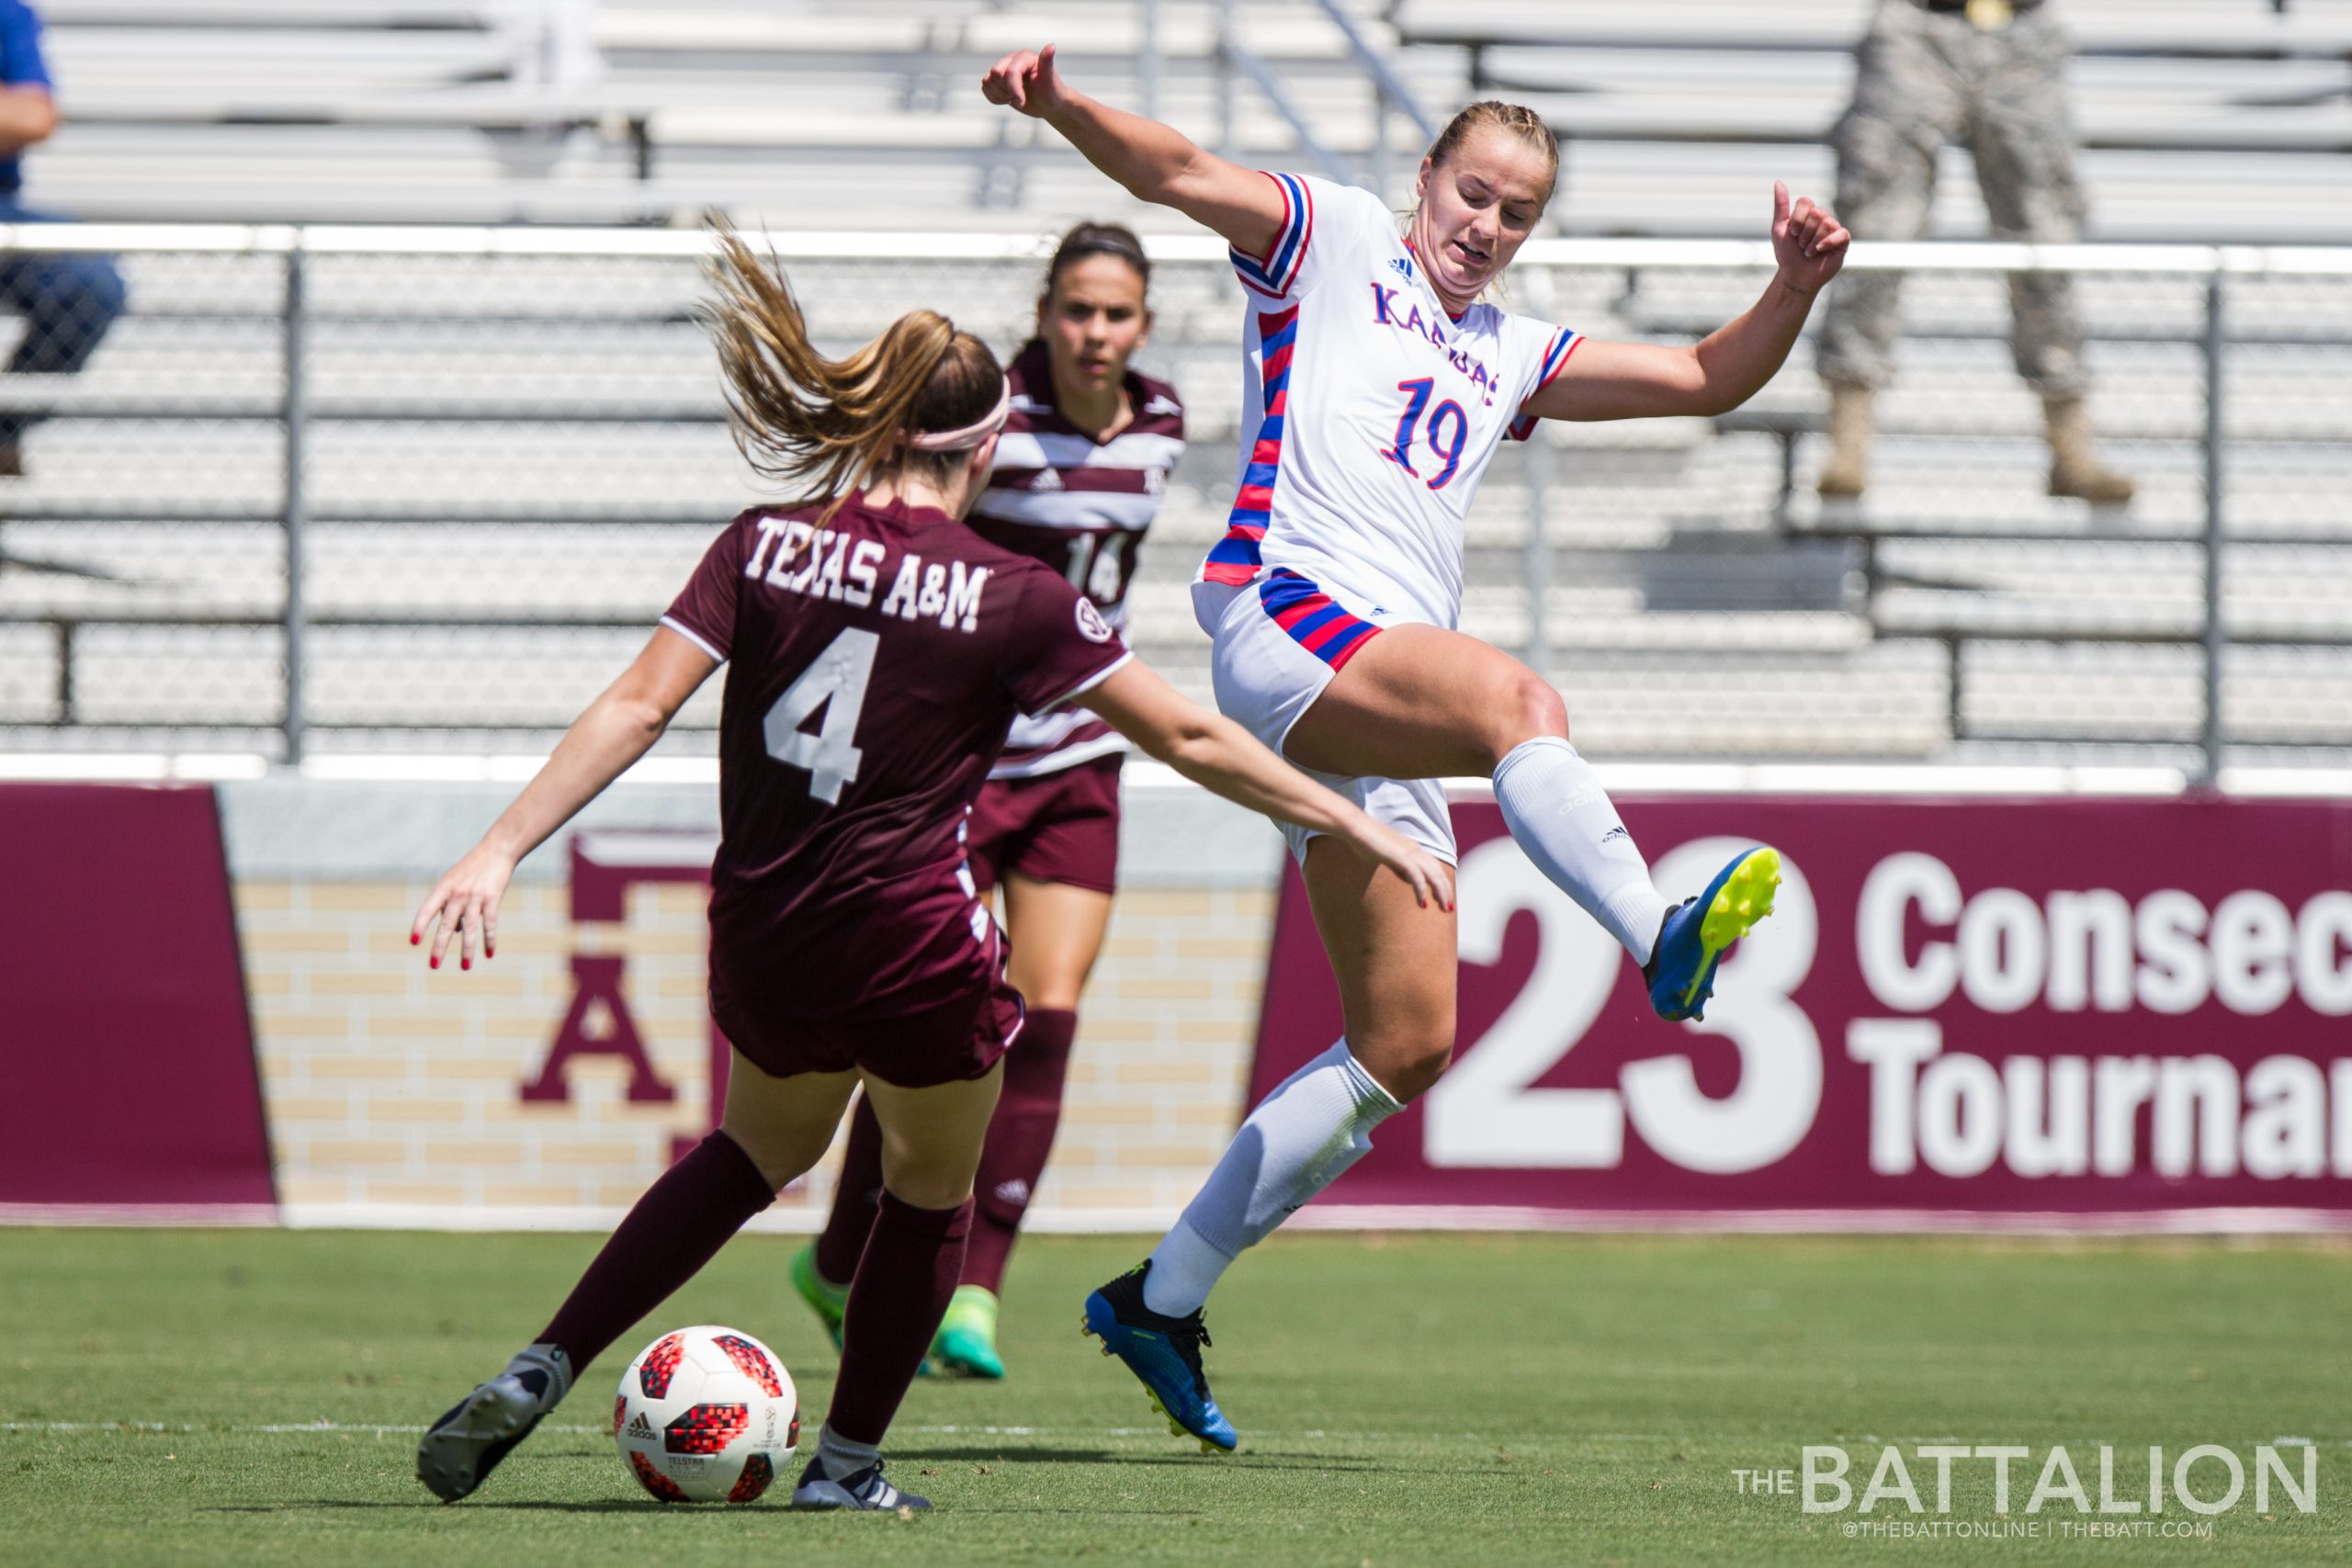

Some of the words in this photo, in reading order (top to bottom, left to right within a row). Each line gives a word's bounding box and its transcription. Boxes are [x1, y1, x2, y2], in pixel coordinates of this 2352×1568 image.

[1380, 377, 1468, 490] 19
[745, 516, 887, 608] TEXAS
[881, 554, 988, 634] A&M
[763, 626, 881, 807] 4
[1423, 835, 1824, 1175] 23
[627, 1427, 658, 1440] adidas
